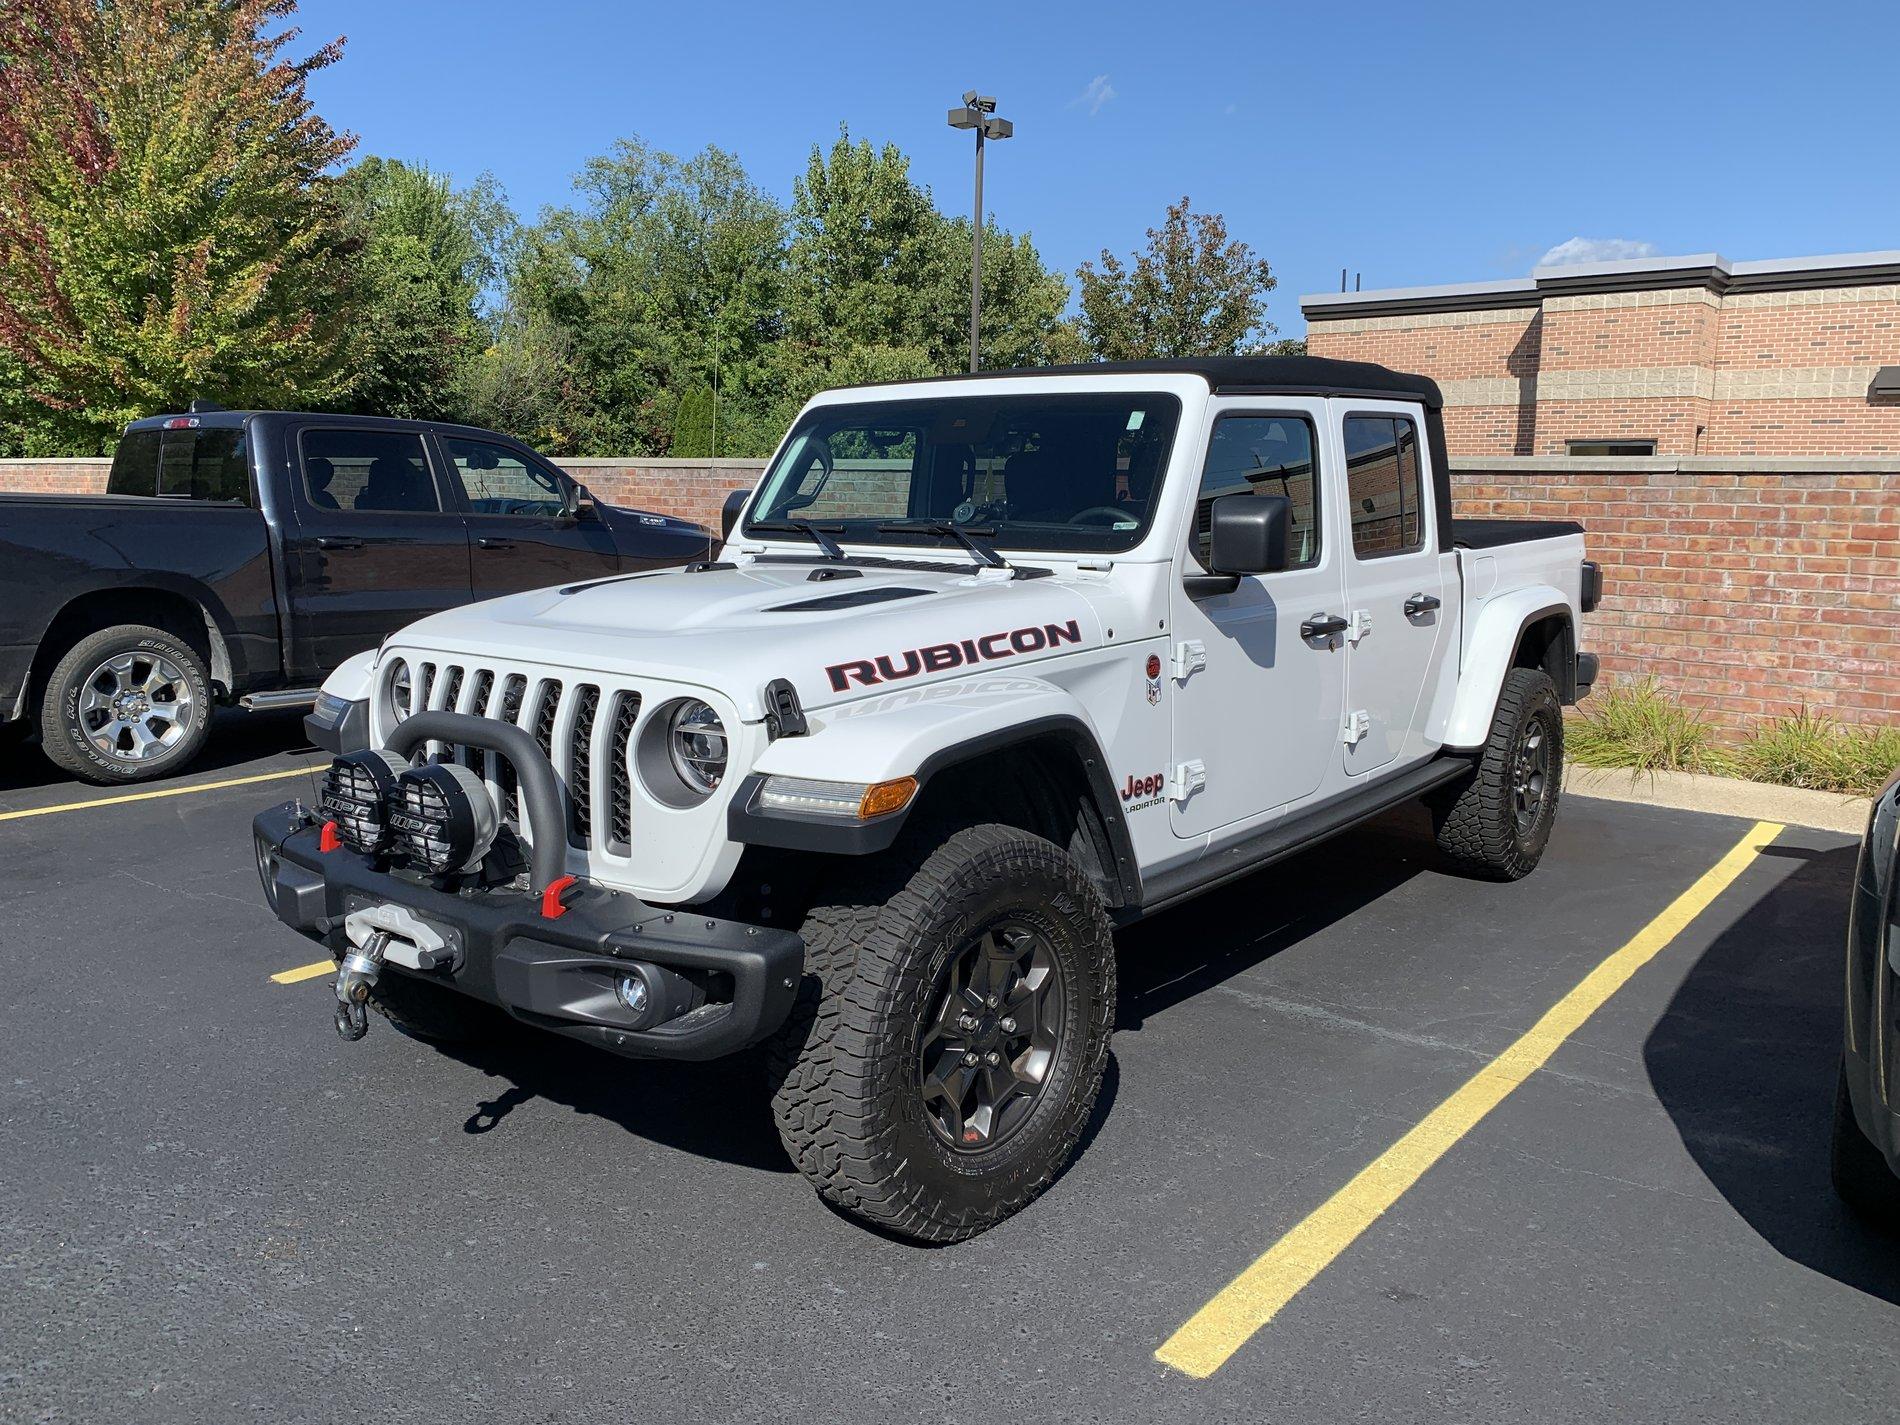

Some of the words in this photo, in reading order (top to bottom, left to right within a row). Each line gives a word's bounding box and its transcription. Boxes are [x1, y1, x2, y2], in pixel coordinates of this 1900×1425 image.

[824, 619, 1083, 693] RUBICON
[138, 639, 208, 730] BRIDGESTONE
[1120, 773, 1164, 802] Jeep
[1125, 797, 1165, 814] LADIATOR
